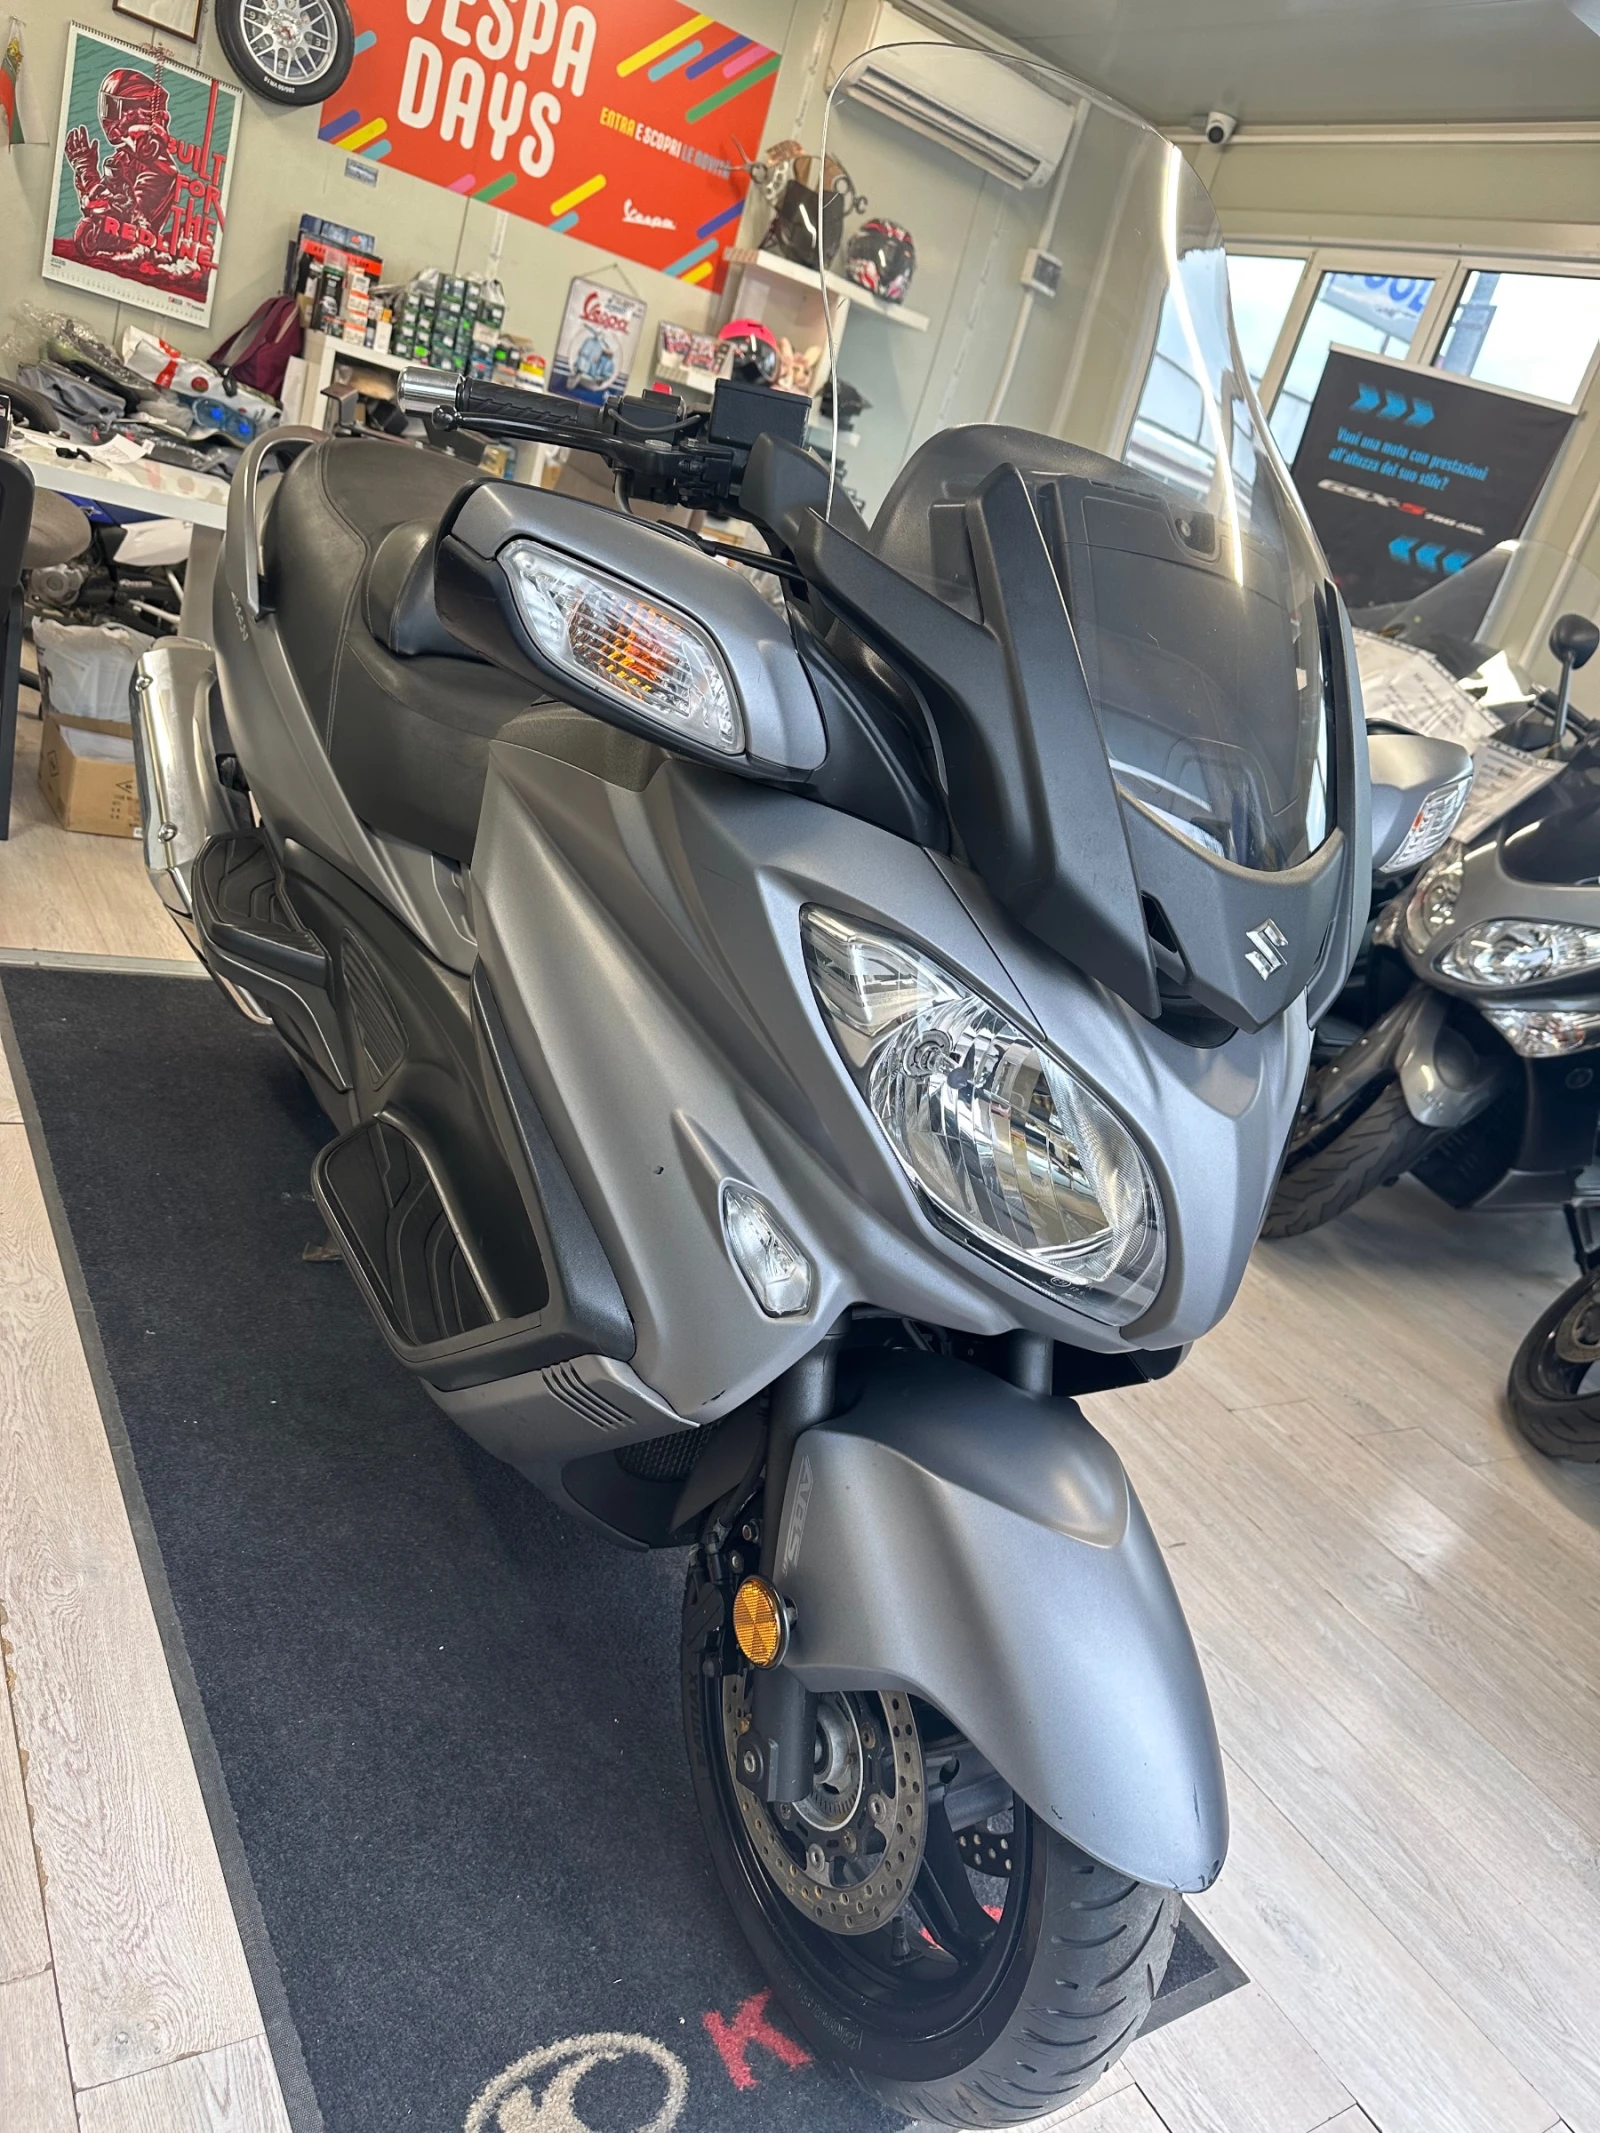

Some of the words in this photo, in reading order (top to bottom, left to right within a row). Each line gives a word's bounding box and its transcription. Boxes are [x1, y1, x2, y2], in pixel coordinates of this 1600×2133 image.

[404, 0, 597, 97] ESPA
[397, 36, 562, 178] DAYS
[600, 107, 636, 138] ENTRA
[635, 122, 644, 141] E
[642, 126, 682, 158] SCOPRI
[681, 144, 695, 164] LE
[170, 198, 216, 252] THE
[175, 173, 225, 233] FOR
[622, 198, 677, 230] Vespa
[104, 216, 218, 269] REDLINE
[579, 291, 629, 335] Vespa
[1336, 426, 1362, 445] Vuoi
[1360, 436, 1381, 452] una
[1381, 441, 1409, 460] moto
[1409, 450, 1430, 465] con
[1429, 455, 1490, 481] prestazioni
